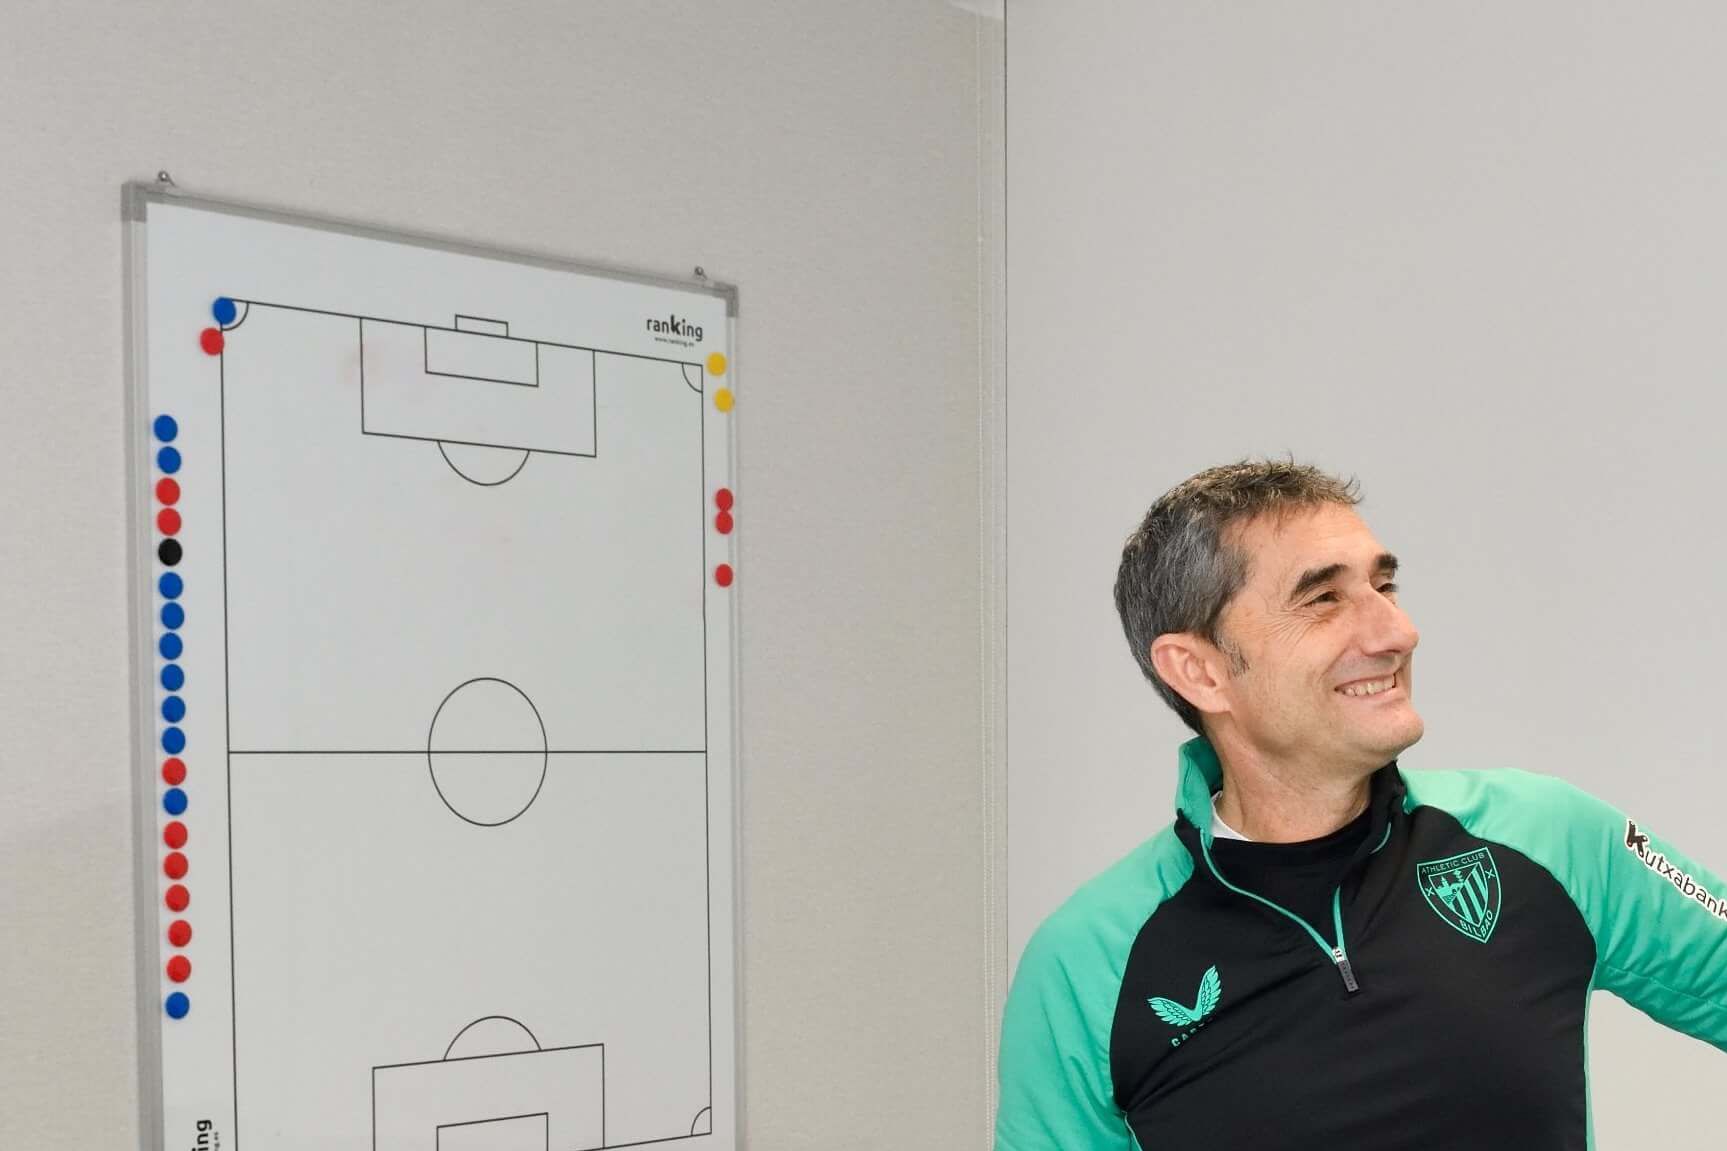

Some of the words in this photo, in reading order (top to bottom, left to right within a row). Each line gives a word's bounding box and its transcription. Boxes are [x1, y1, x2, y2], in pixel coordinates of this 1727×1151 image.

[646, 314, 703, 342] ranking
[1421, 860, 1460, 874] ATHLETIC
[1460, 852, 1485, 864] CLUB
[1459, 909, 1493, 938] BILBAO
